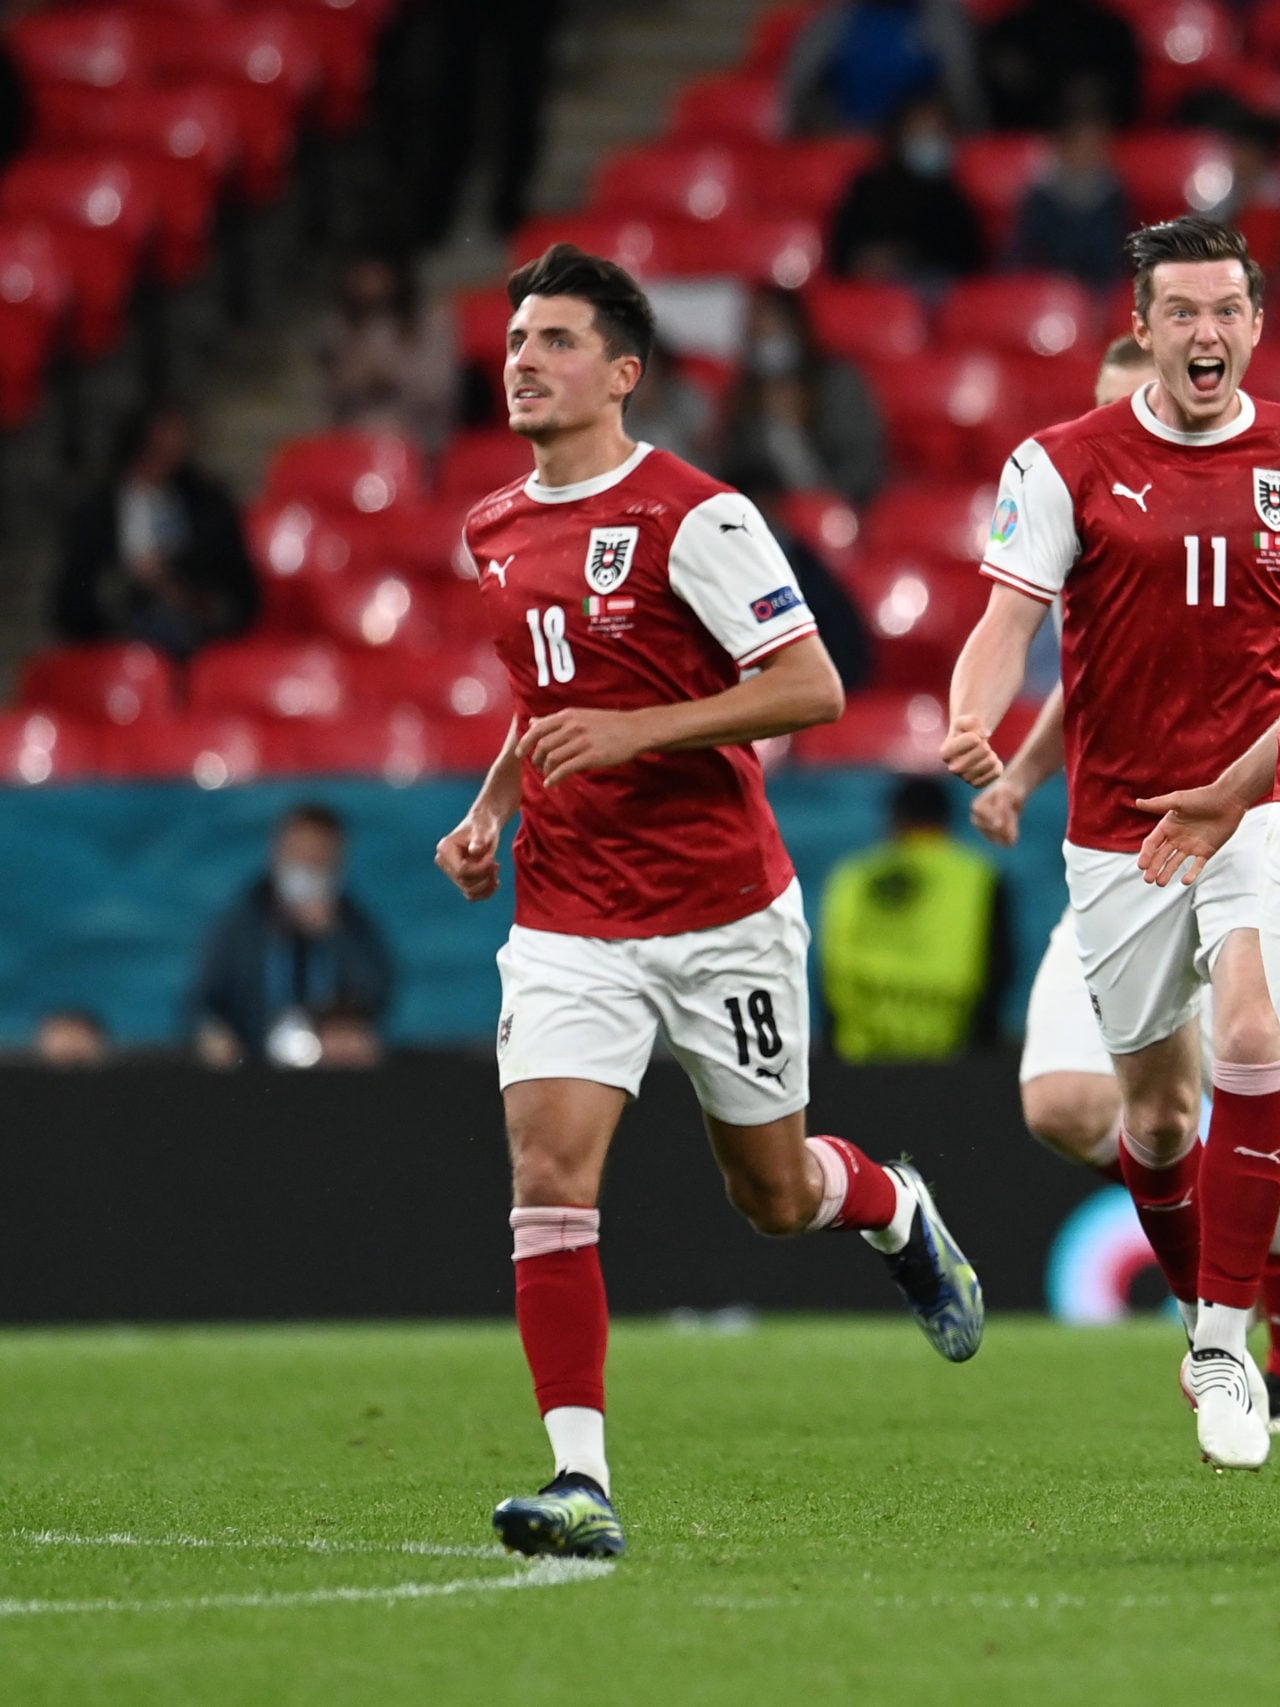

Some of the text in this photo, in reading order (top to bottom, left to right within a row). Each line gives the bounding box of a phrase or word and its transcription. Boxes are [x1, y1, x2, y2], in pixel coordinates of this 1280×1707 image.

[1184, 535, 1227, 607] 11
[526, 605, 575, 687] 18
[724, 990, 783, 1066] 18
